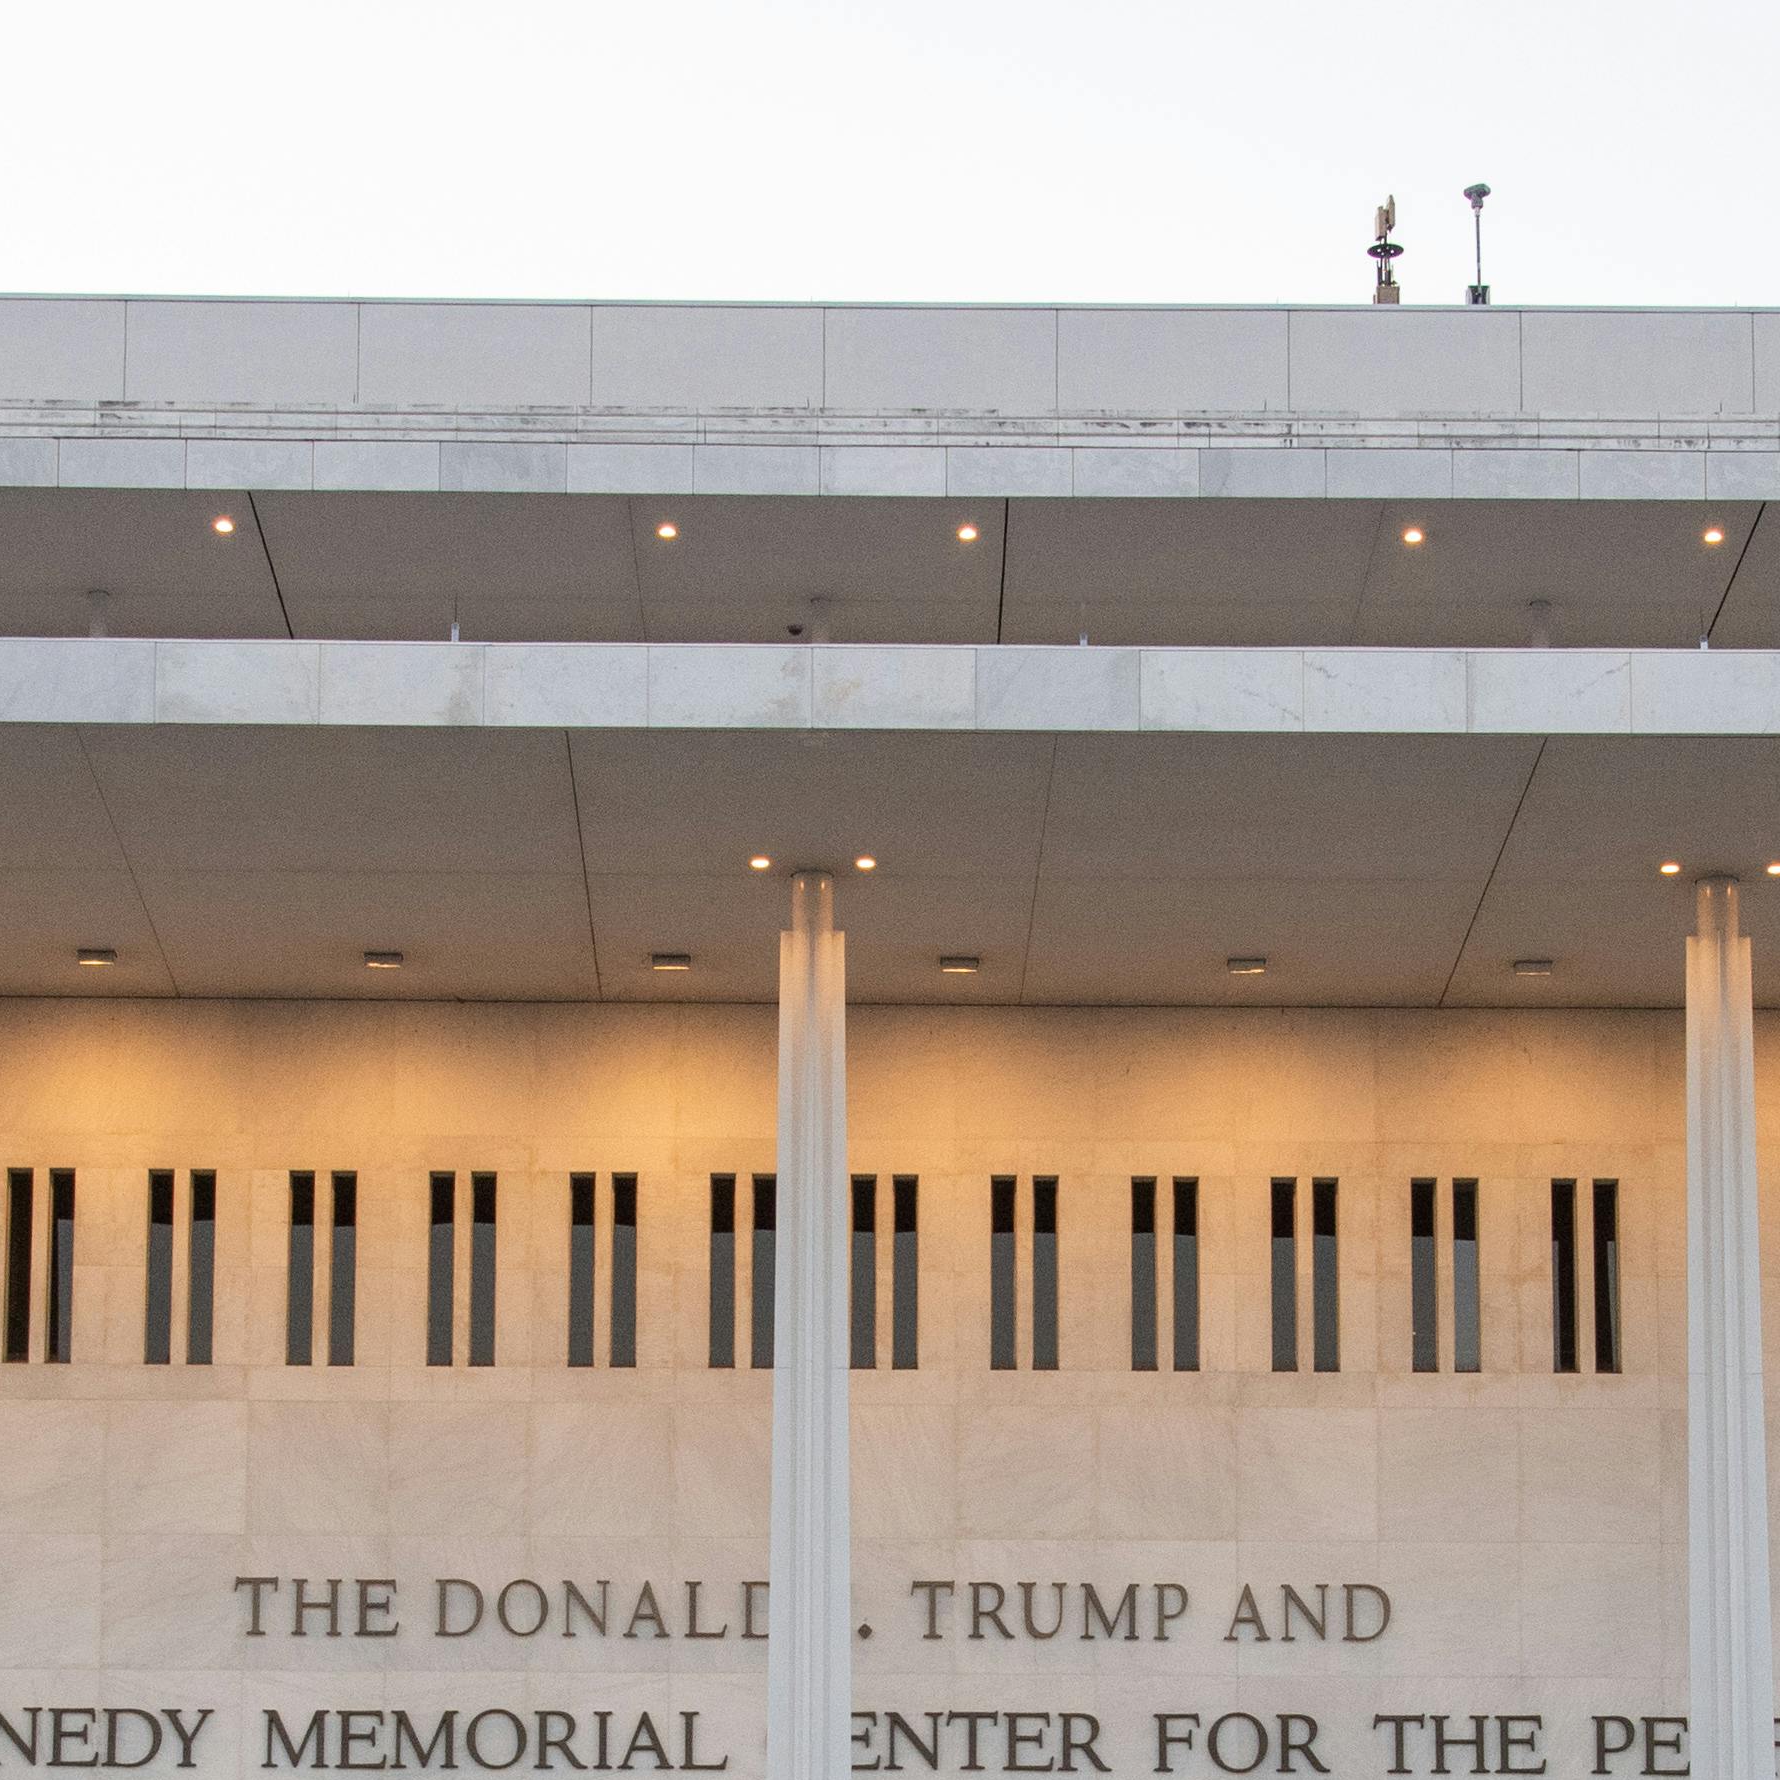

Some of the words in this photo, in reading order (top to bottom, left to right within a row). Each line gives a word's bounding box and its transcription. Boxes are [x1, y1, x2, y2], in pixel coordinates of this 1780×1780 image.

[234, 1576, 399, 1638] THE
[910, 1580, 1188, 1642] TRUMP
[1224, 1584, 1391, 1643] AND
[261, 1709, 728, 1771] MEMORIAL
[765, 1710, 1112, 1773] ENTER
[1153, 1712, 1331, 1774] FOR
[1373, 1713, 1546, 1775] THE
